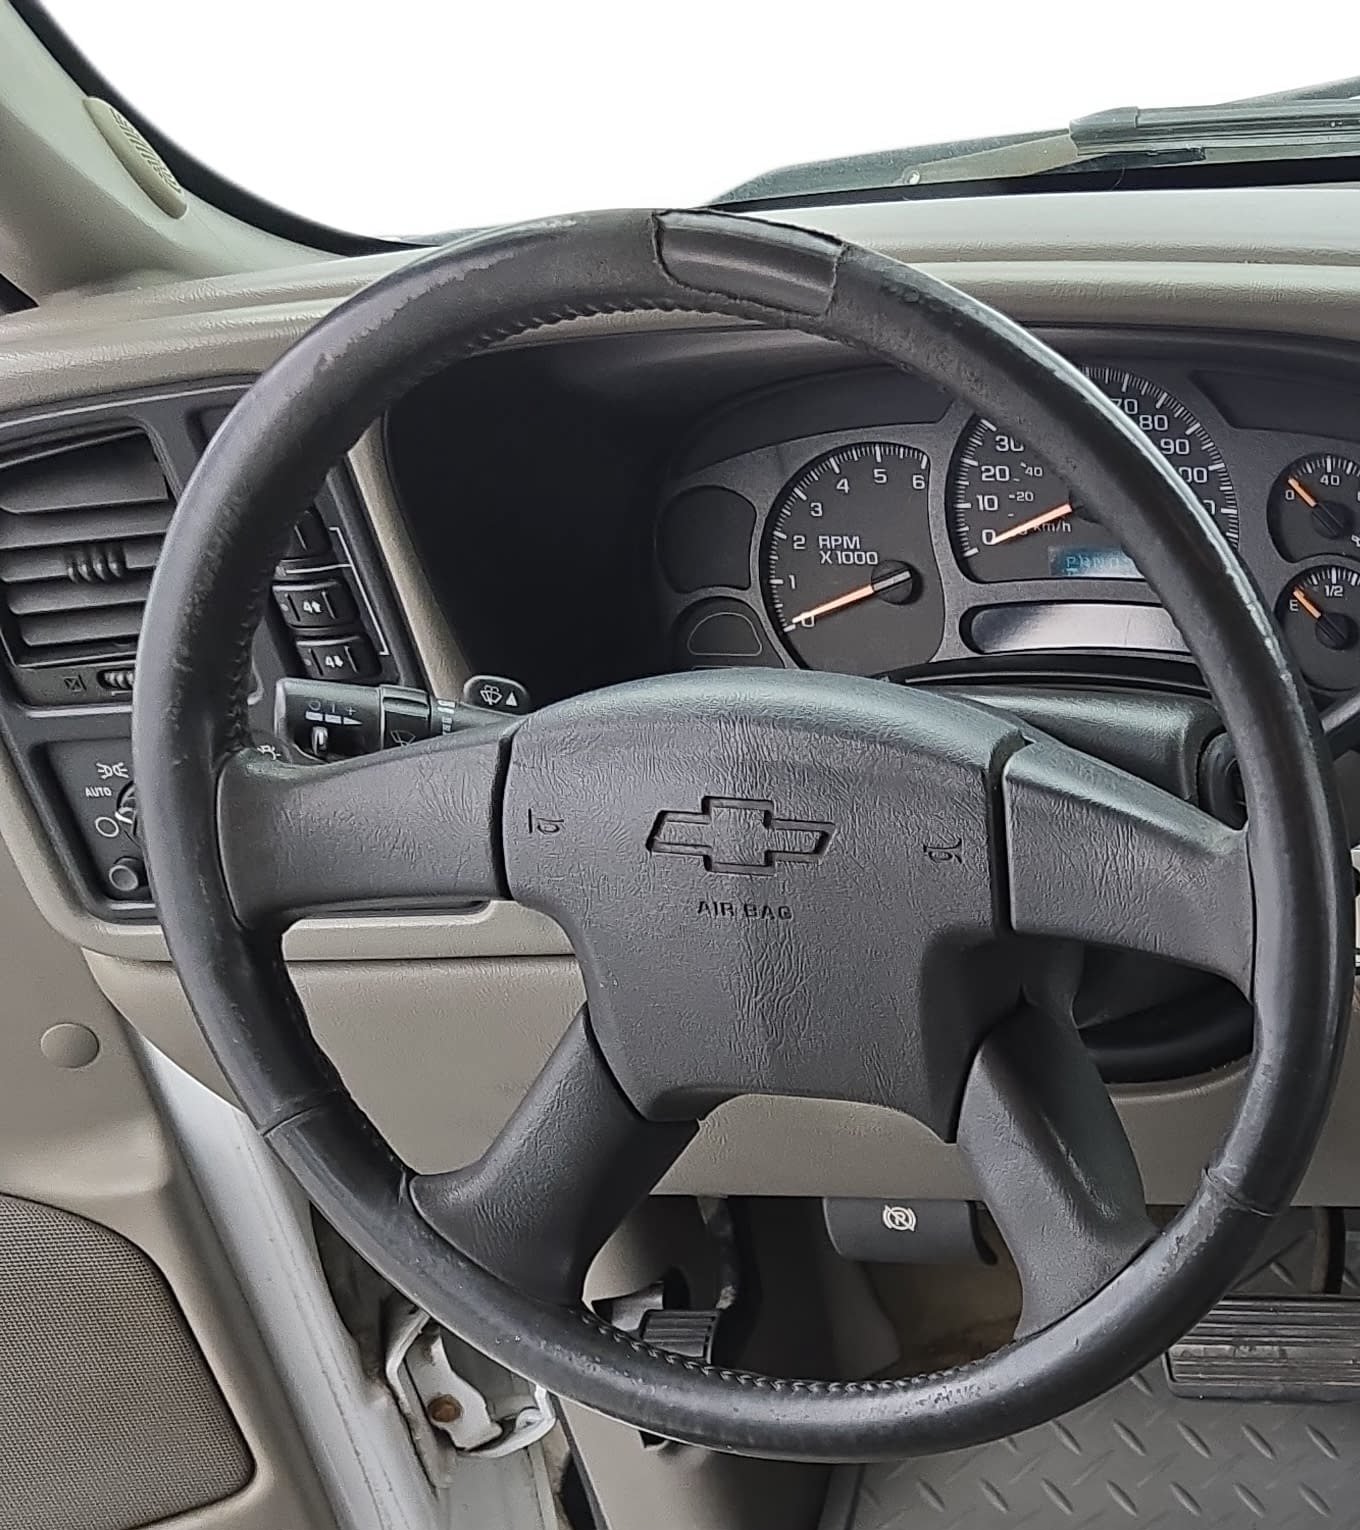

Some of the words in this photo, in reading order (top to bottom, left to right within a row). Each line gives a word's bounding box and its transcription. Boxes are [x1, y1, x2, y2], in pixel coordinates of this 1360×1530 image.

[1139, 415, 1168, 431] 80
[995, 435, 1024, 451] 30
[1160, 439, 1190, 454] 90
[873, 469, 887, 484] 5
[981, 466, 1010, 481] 20
[1025, 467, 1043, 477] 40
[836, 478, 850, 493] 4
[912, 475, 926, 489] 6
[1320, 475, 1340, 486] 40
[1016, 492, 1034, 501] 20
[1285, 490, 1295, 500] 0
[810, 502, 823, 517] 3
[977, 495, 998, 511] 10
[793, 536, 806, 550] 2
[818, 536, 860, 549] RPM
[789, 575, 796, 589] 1
[1325, 585, 1344, 597] 1/2
[1290, 601, 1299, 611] E
[85, 787, 112, 797] AUTO
